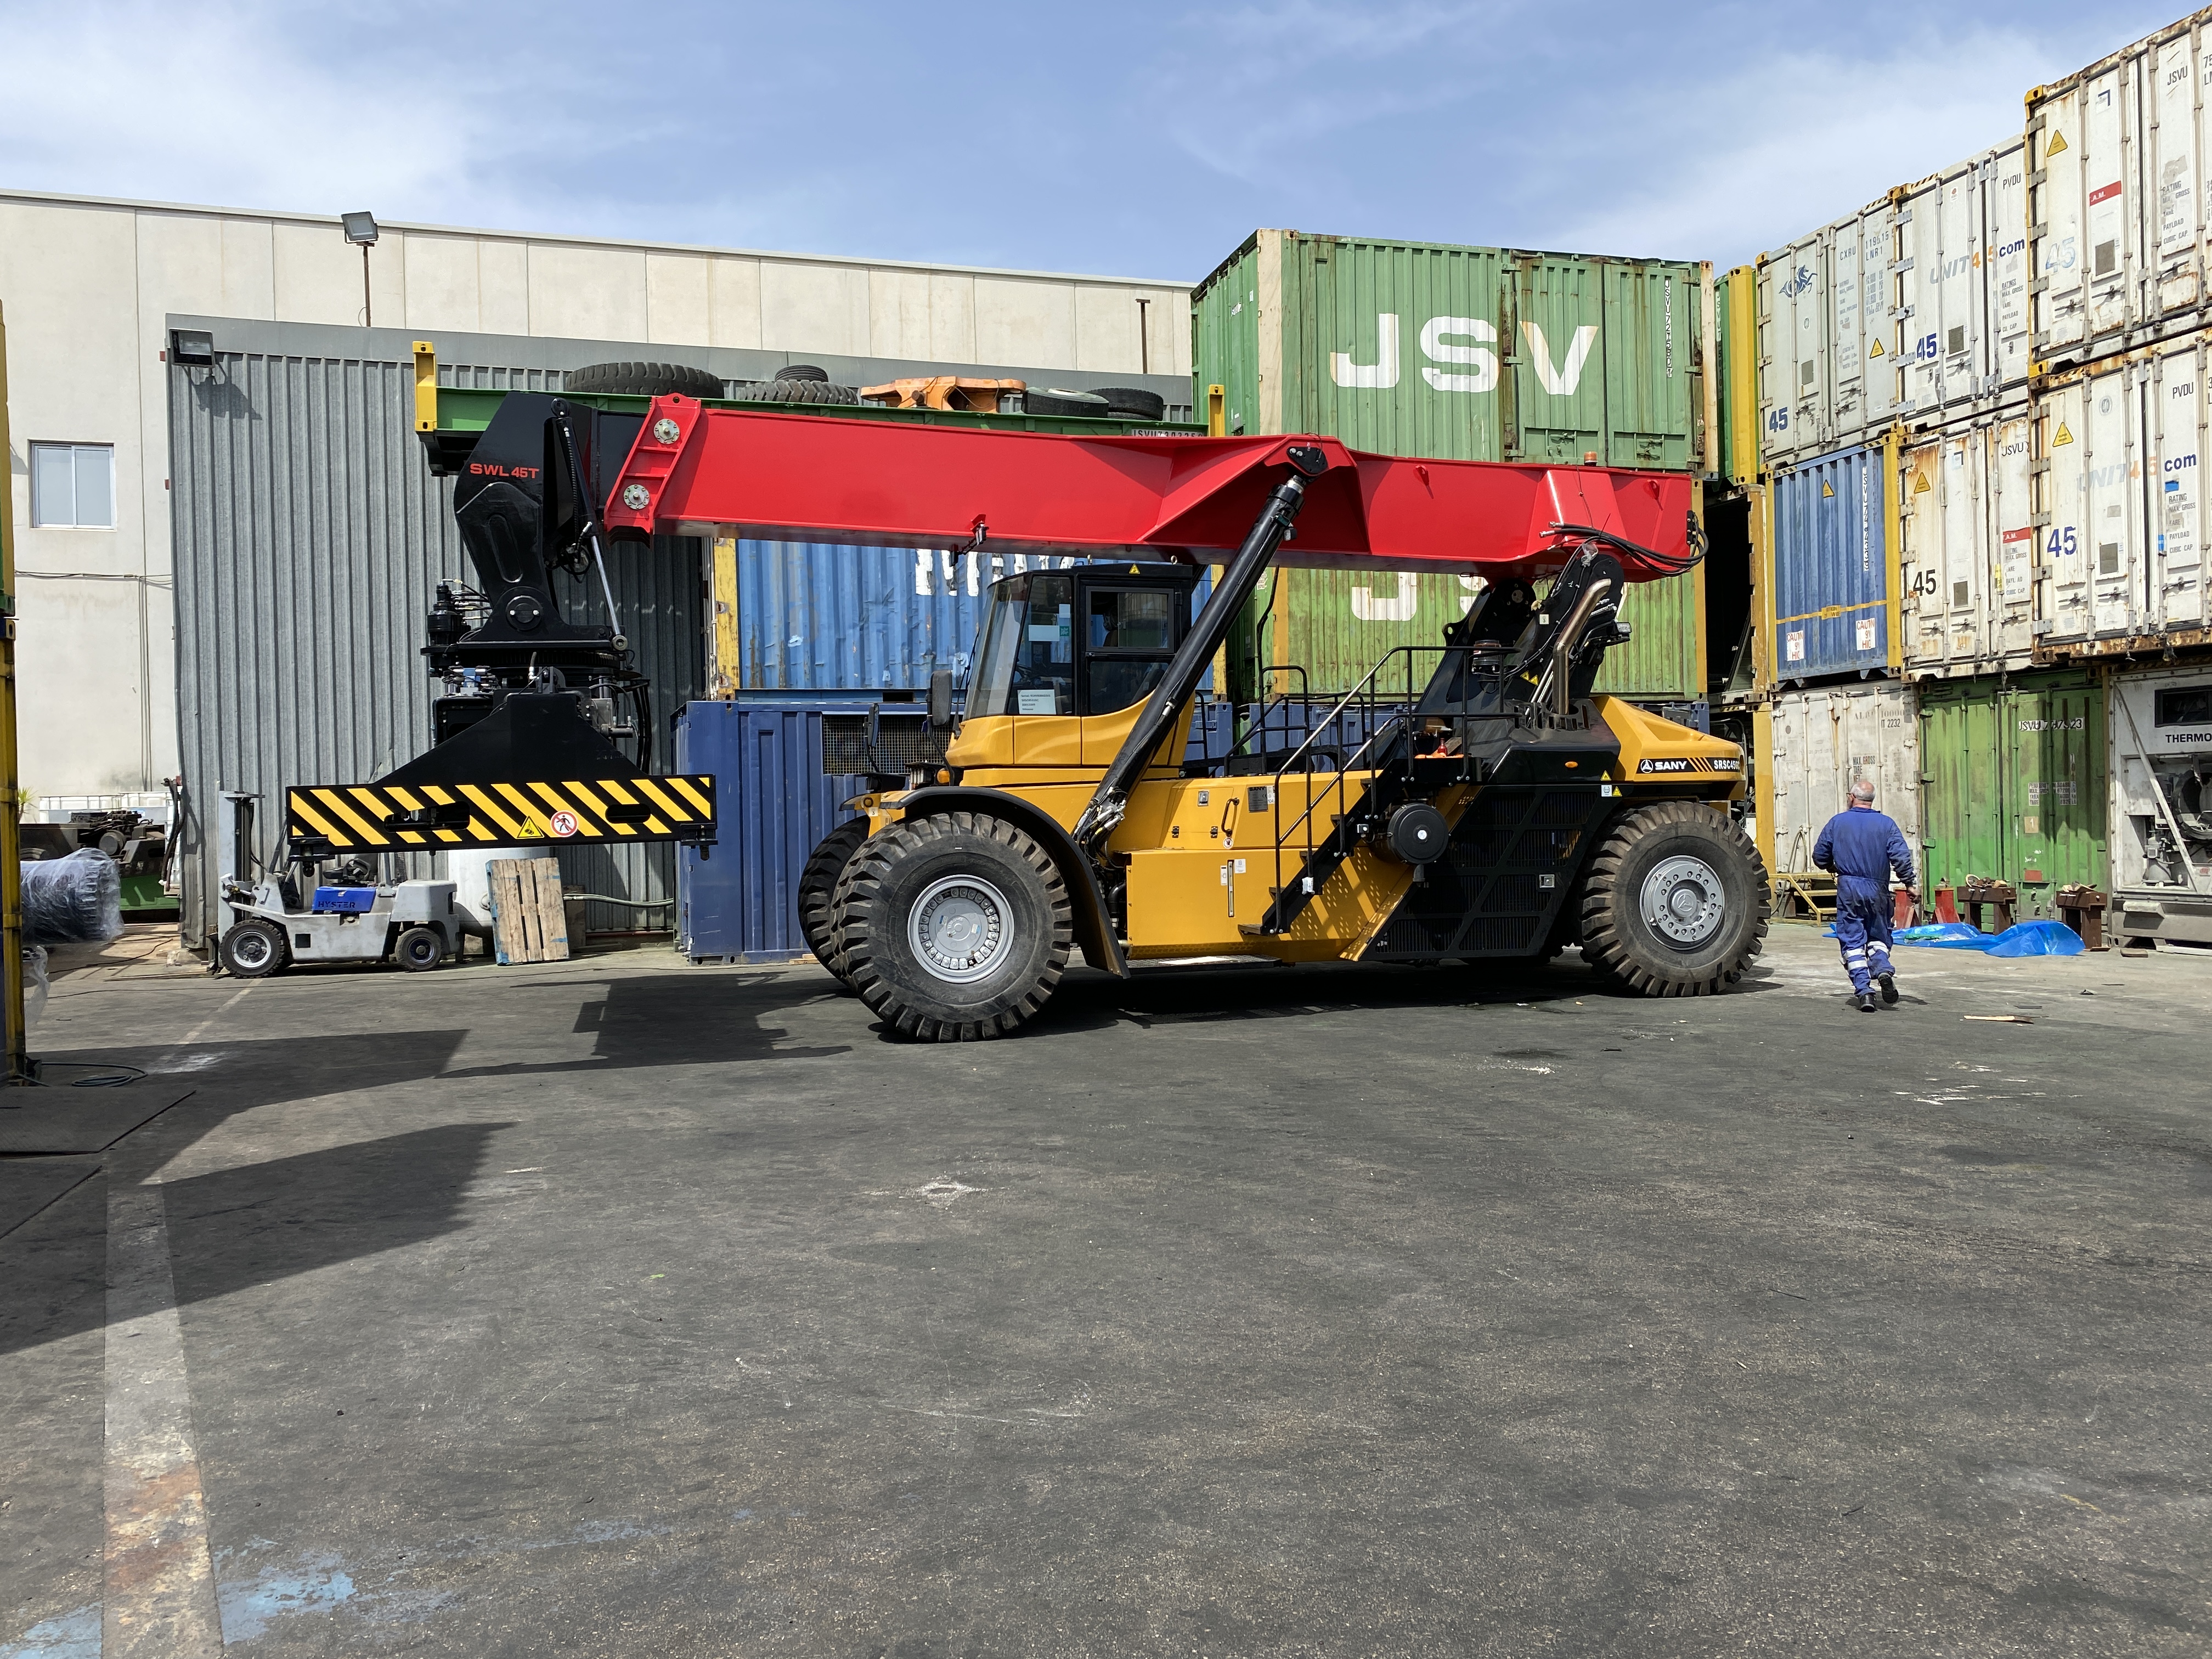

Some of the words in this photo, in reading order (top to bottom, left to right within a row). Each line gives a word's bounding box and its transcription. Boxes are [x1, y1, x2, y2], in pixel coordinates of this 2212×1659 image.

[2168, 66, 2188, 86] JSVU
[2003, 173, 2021, 189] PVDU
[2163, 180, 2181, 195] RATING
[2176, 188, 2190, 199] GROSS
[2163, 218, 2183, 230] PAYLOAD
[2164, 235, 2176, 244] CUBIC
[1840, 246, 1856, 261] CXRU
[2045, 236, 2075, 273] 45
[2012, 285, 2023, 294] GROSS
[2002, 311, 2018, 320] PAYLOAD
[1917, 333, 1937, 360] 45
[1330, 313, 1599, 396] JSV
[2172, 381, 2193, 399] PVDU
[1769, 407, 1788, 432] 45
[2002, 443, 2024, 456] JSVU
[470, 464, 509, 477] SWL
[511, 467, 539, 478] 45T
[2169, 493, 2187, 503] RATING
[2182, 503, 2196, 511] GROSS
[2047, 526, 2077, 557] 45
[2170, 531, 2190, 540] PAYLOAD
[1913, 569, 1936, 596] 45
[1881, 719, 1885, 728] IT
[1887, 719, 1900, 728] 2232
[1655, 760, 1687, 770] SANY
[1863, 755, 1875, 764] GROSS
[1853, 765, 1863, 774] TARE
